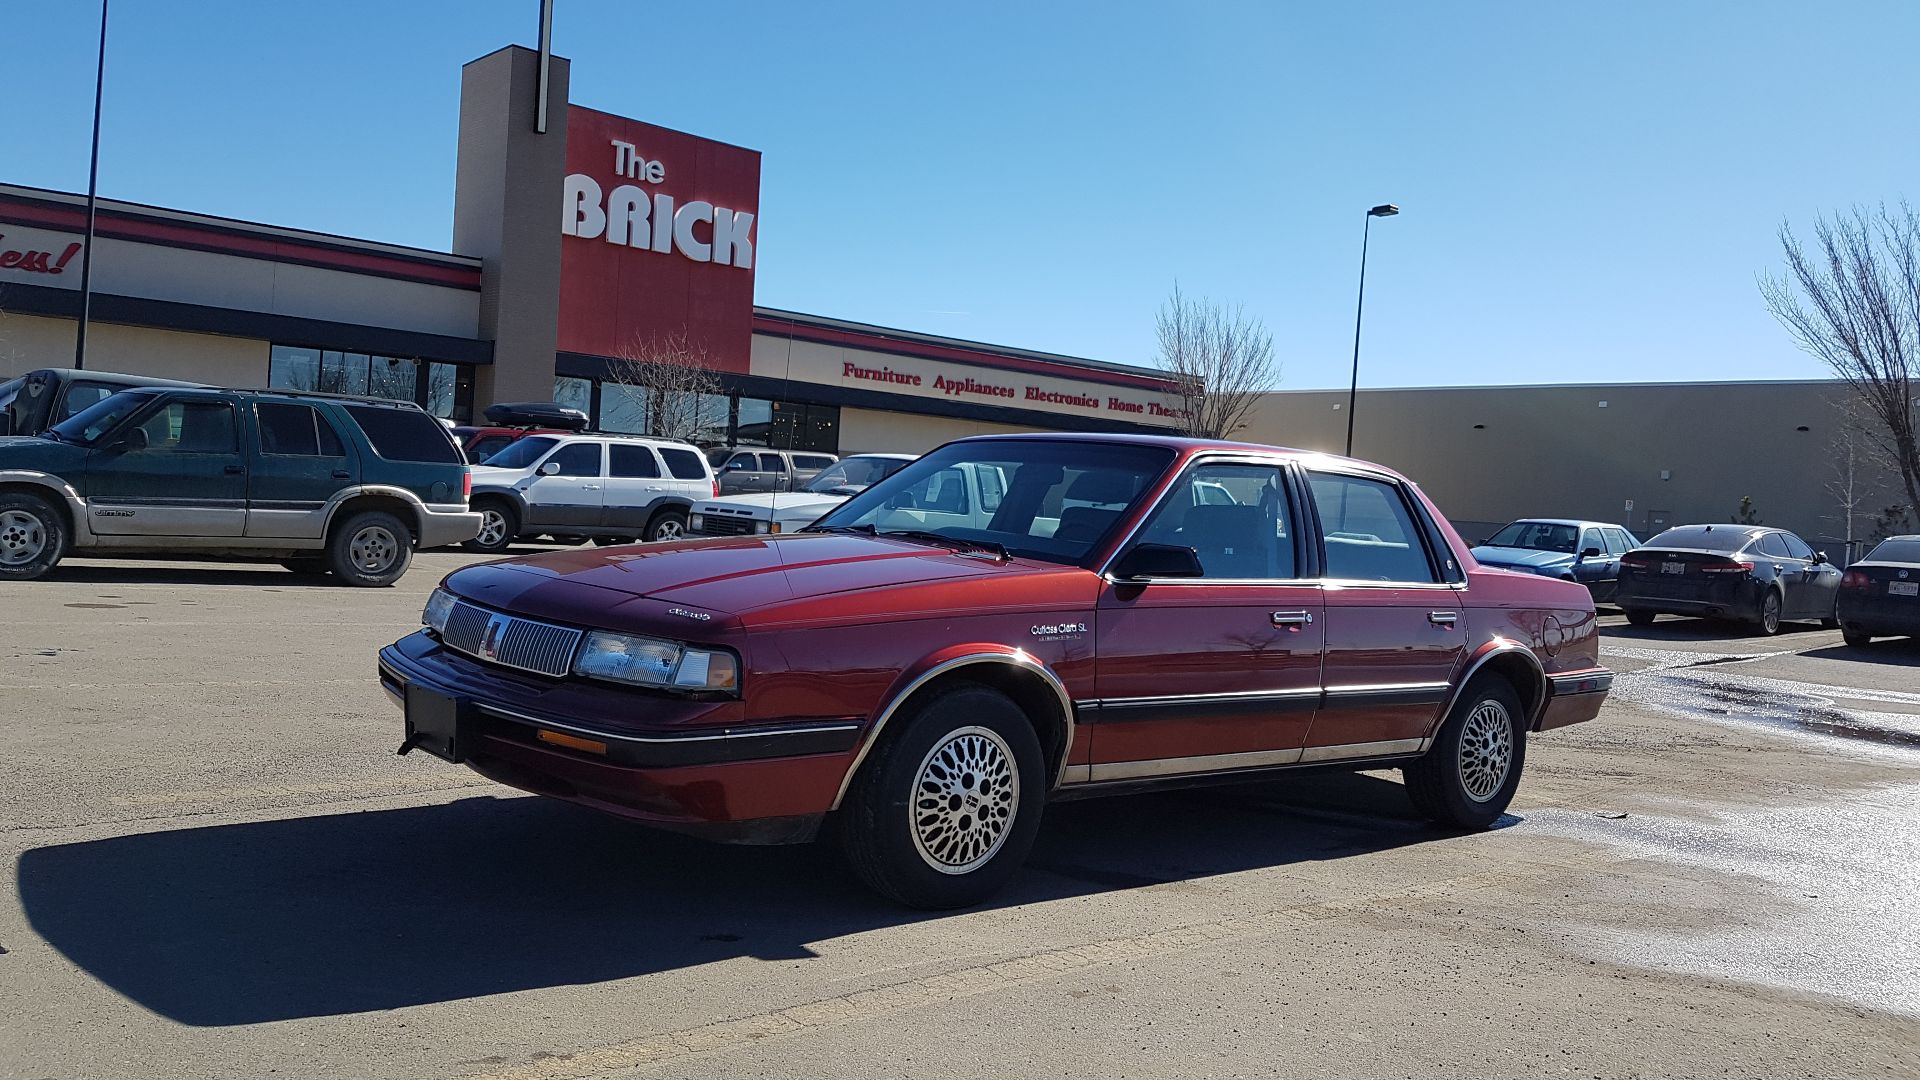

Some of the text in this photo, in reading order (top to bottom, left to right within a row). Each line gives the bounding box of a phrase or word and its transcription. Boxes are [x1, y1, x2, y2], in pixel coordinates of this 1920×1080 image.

[610, 139, 665, 184] The
[561, 173, 755, 270] BRICK
[0, 234, 82, 274] ess!
[842, 362, 922, 386] Furniture
[933, 374, 1015, 398] Appliances
[1025, 386, 1100, 409] Electronics
[1107, 397, 1144, 414] Home
[1030, 624, 1058, 635] Cutlass
[1077, 622, 1088, 632] SL
